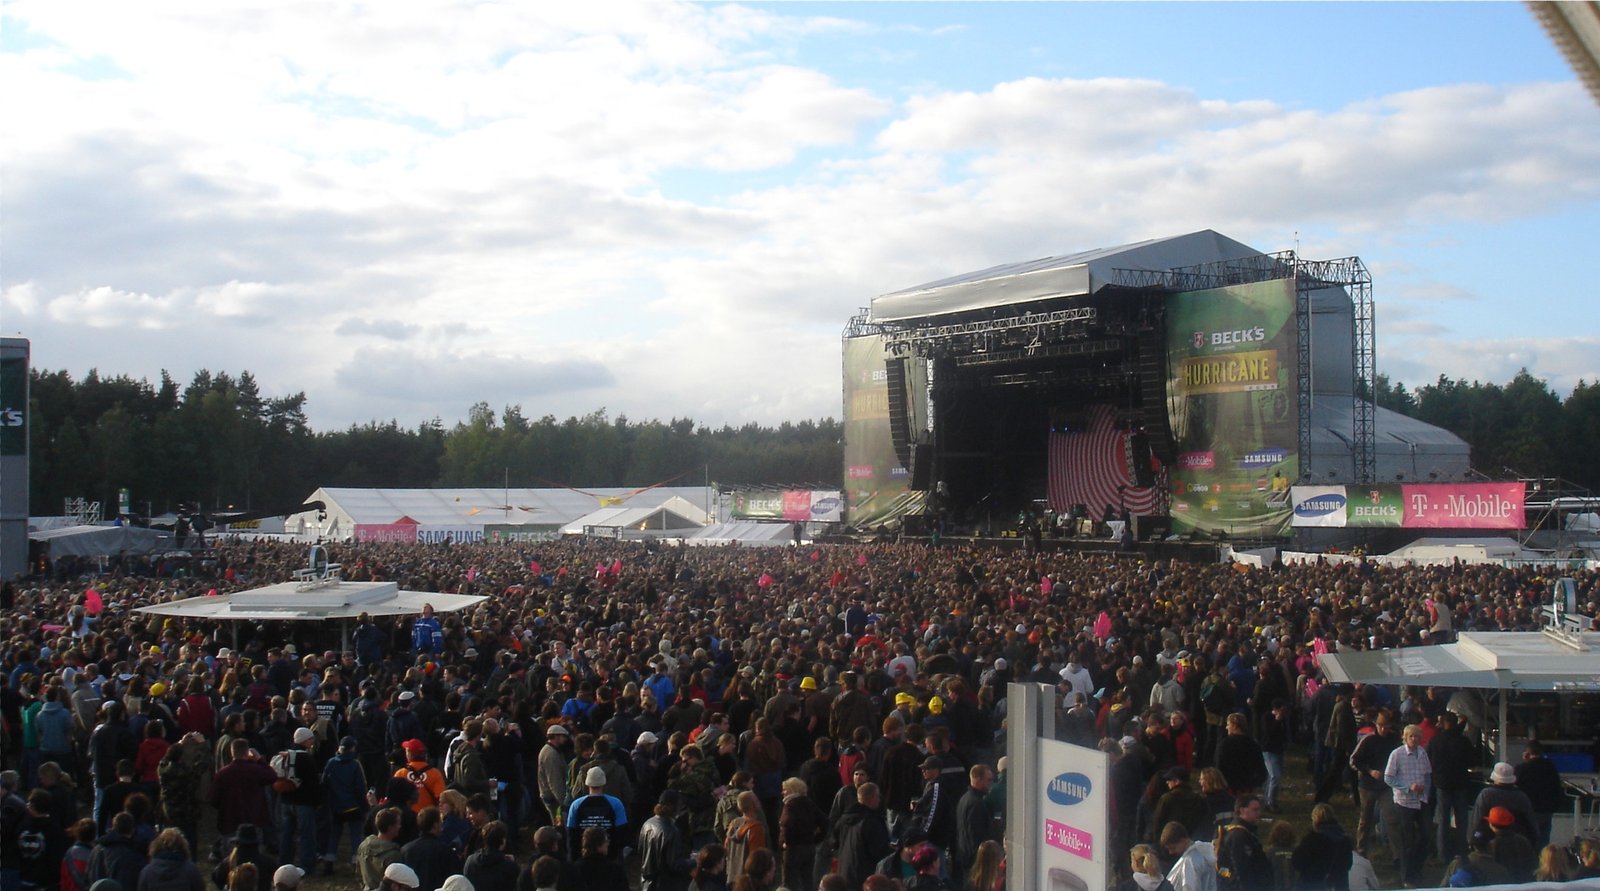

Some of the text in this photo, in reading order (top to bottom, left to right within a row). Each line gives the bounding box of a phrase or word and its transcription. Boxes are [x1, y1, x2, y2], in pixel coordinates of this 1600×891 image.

[1211, 326, 1265, 345] BECK'S
[1184, 358, 1270, 386] HURRICANE
[1244, 454, 1283, 464] SAMSUNG
[1300, 500, 1341, 511] SAMSUNG
[1355, 505, 1398, 517] BECK'S
[417, 530, 482, 544] SAMSUNG
[1051, 778, 1088, 801] SAMSUNG
